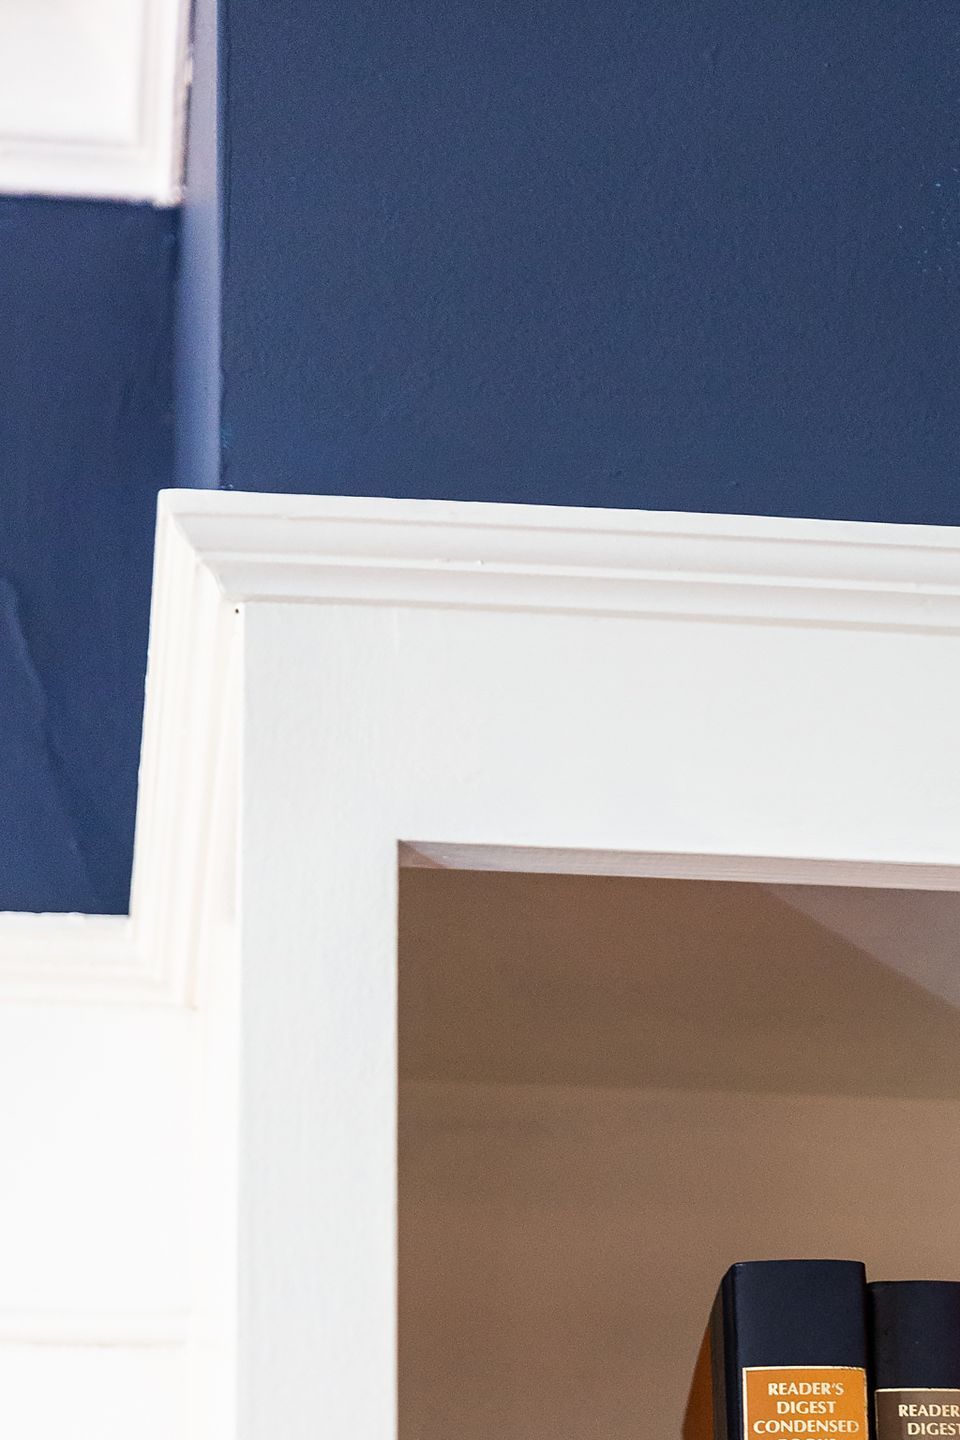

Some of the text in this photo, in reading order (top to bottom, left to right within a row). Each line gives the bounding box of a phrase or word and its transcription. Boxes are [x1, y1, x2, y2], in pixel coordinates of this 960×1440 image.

[768, 1382, 844, 1396] READER'S
[776, 1401, 836, 1414] DIGEST
[753, 1420, 859, 1434] CONDENSED
